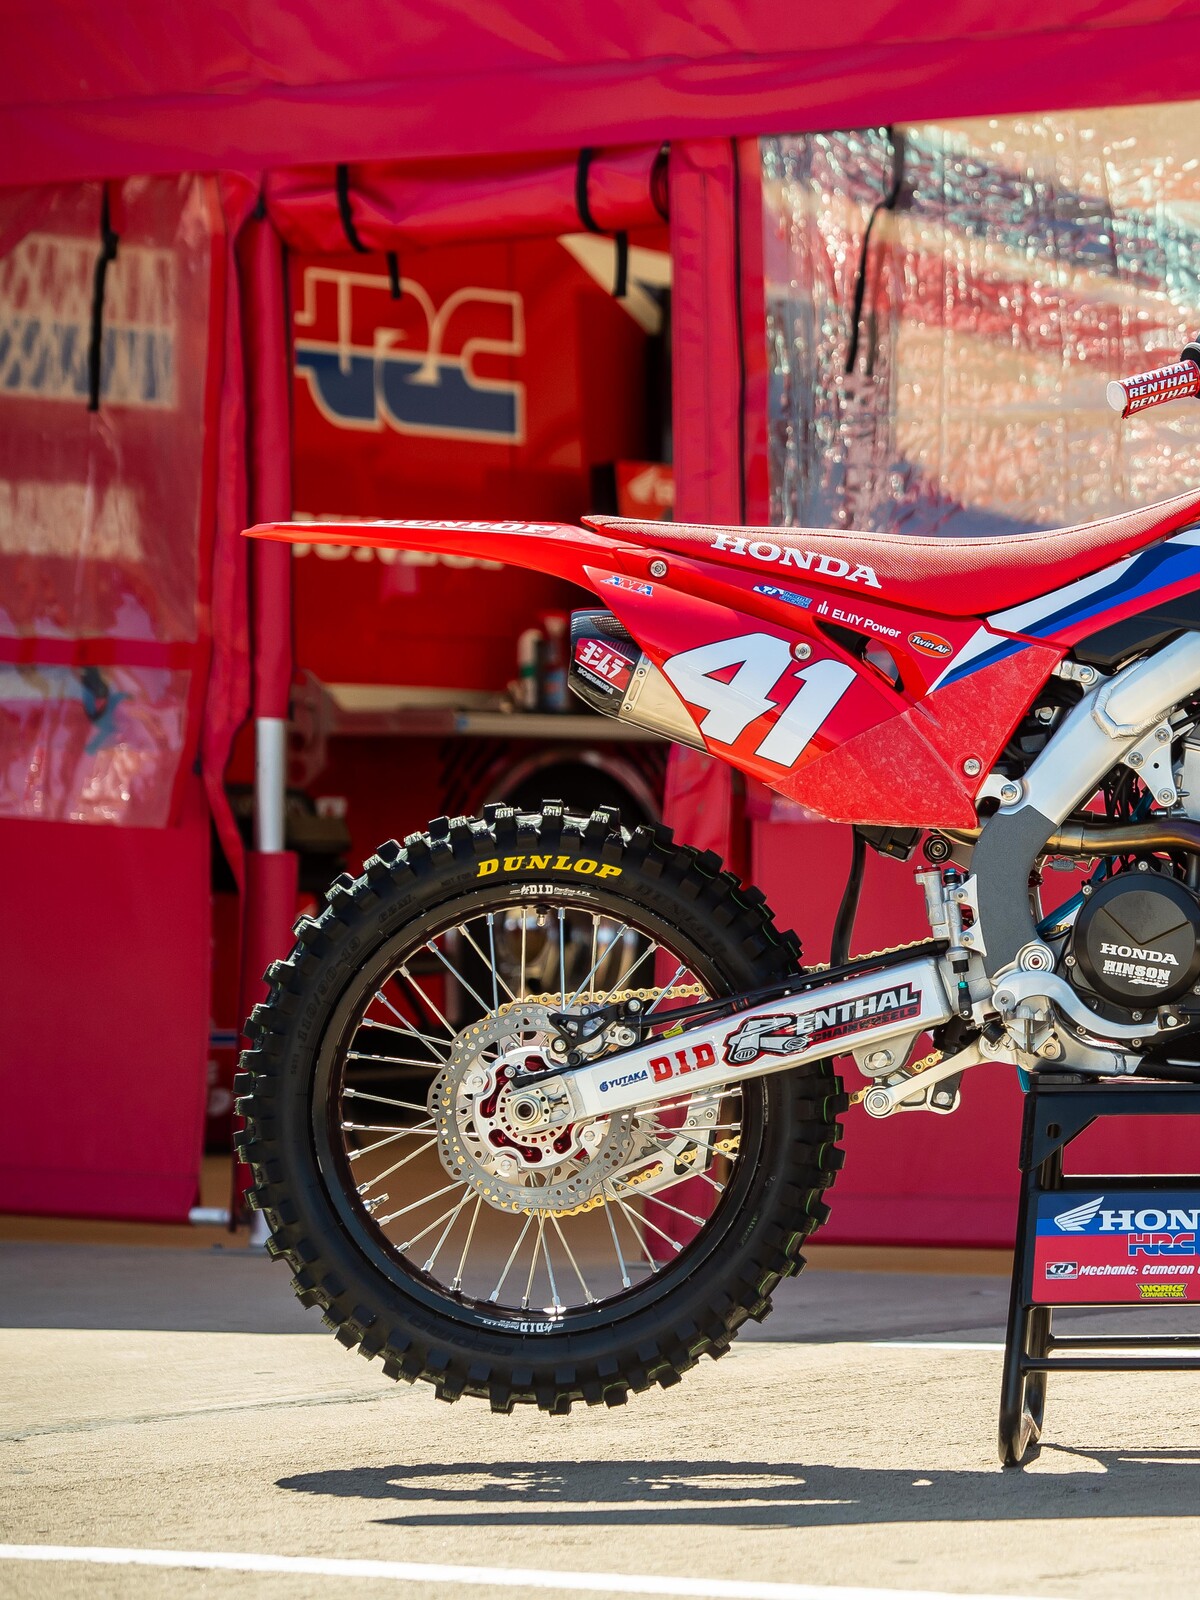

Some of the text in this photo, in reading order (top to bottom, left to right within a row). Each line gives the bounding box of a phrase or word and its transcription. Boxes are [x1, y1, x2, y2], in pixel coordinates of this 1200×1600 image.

[1124, 362, 1194, 387] RENTHAL
[1129, 373, 1197, 398] RENTHAL
[1130, 384, 1196, 410] RENTHAL
[370, 519, 560, 533] DUNLOP
[711, 533, 882, 589] HONDA
[600, 575, 653, 597] AMA
[863, 619, 901, 638] Power
[912, 635, 950, 654] Twin Air
[579, 641, 625, 679] ヨシムラ
[577, 667, 614, 695] YOSHIMURA
[662, 632, 858, 768] 41
[476, 855, 623, 879] DUNLOP
[1100, 943, 1179, 965] HONDA
[1103, 960, 1171, 980] HINSON
[650, 1043, 715, 1082] D.I.D
[608, 1070, 648, 1087] YUTAKA
[1128, 1233, 1195, 1256] HRC
[1079, 1265, 1139, 1276] Mechanic:
[1142, 1264, 1194, 1275] Cameron
[1140, 1284, 1185, 1292] WORKS
[1141, 1290, 1185, 1298] CONNECTION
